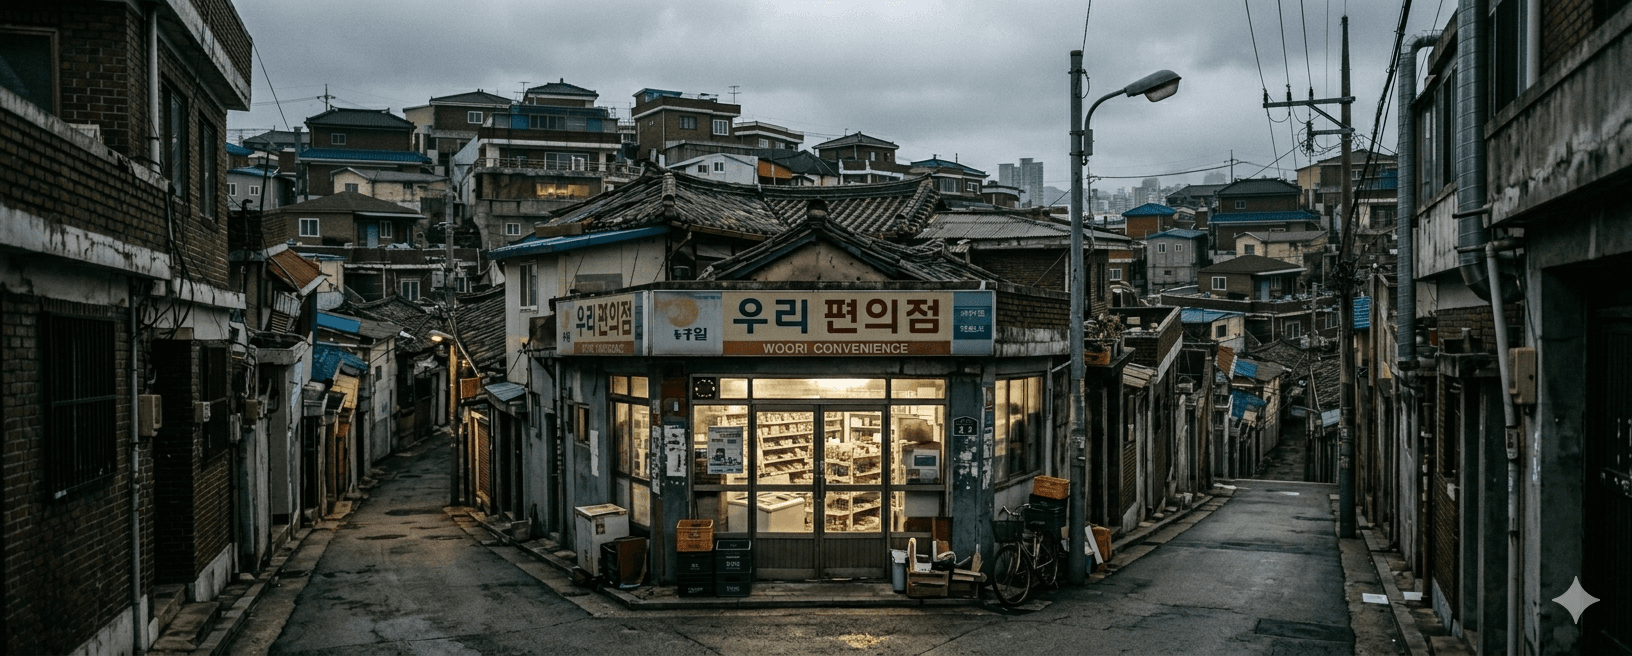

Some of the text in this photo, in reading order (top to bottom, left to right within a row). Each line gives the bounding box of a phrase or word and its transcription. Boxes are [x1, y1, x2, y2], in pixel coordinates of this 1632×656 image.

[576, 304, 596, 337] 우리
[733, 297, 939, 334] 우리 편의점
[763, 343, 908, 354] WOORI CONVENIENCE
